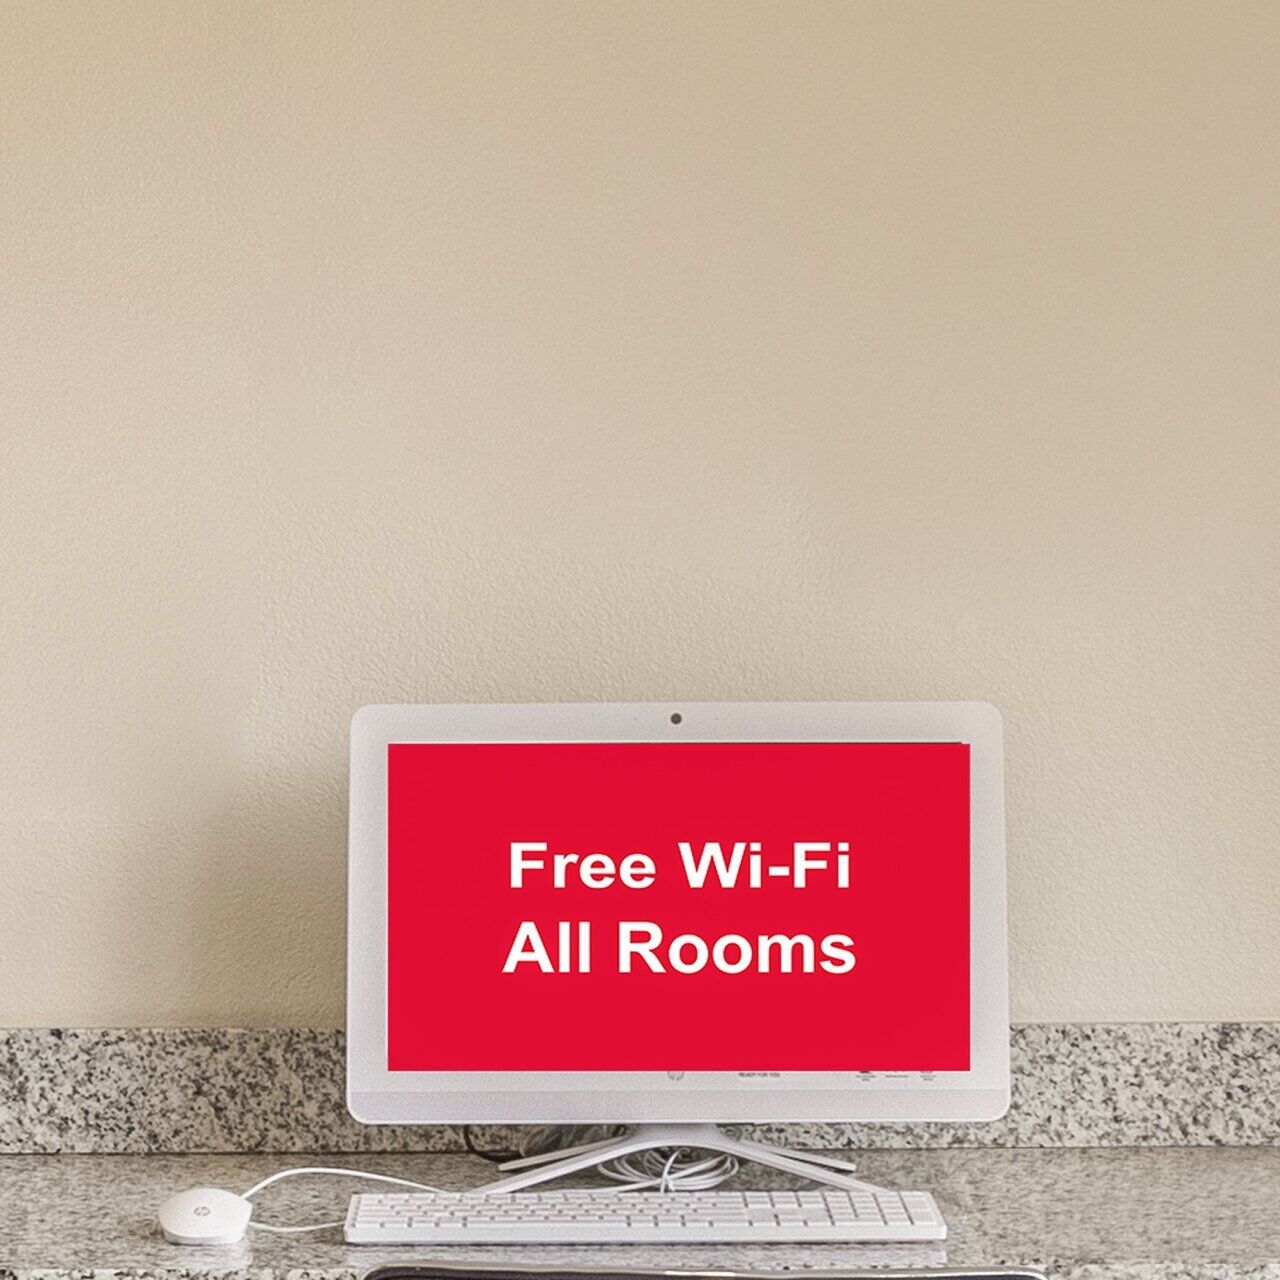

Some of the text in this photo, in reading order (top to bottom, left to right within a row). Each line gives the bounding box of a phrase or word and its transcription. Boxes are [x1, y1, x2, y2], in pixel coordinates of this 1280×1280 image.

[510, 842, 850, 889] Free Wi-Fi
[502, 921, 856, 974] All Rooms
